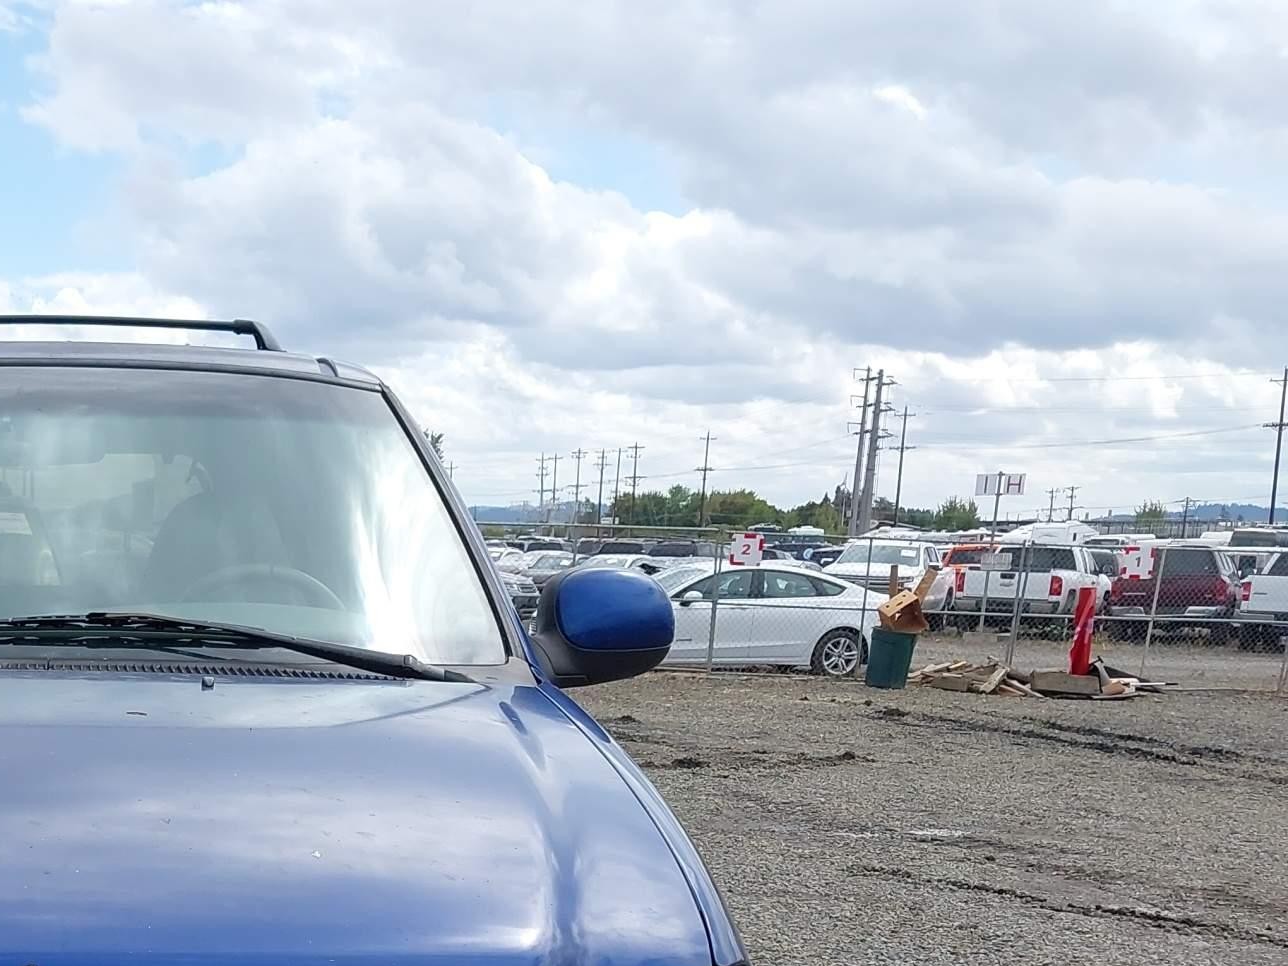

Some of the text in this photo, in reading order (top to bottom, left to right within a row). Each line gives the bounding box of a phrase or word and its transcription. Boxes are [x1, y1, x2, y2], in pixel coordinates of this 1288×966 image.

[1006, 475, 1022, 494] H
[741, 543, 752, 556] 2
[1135, 556, 1141, 569] 1
